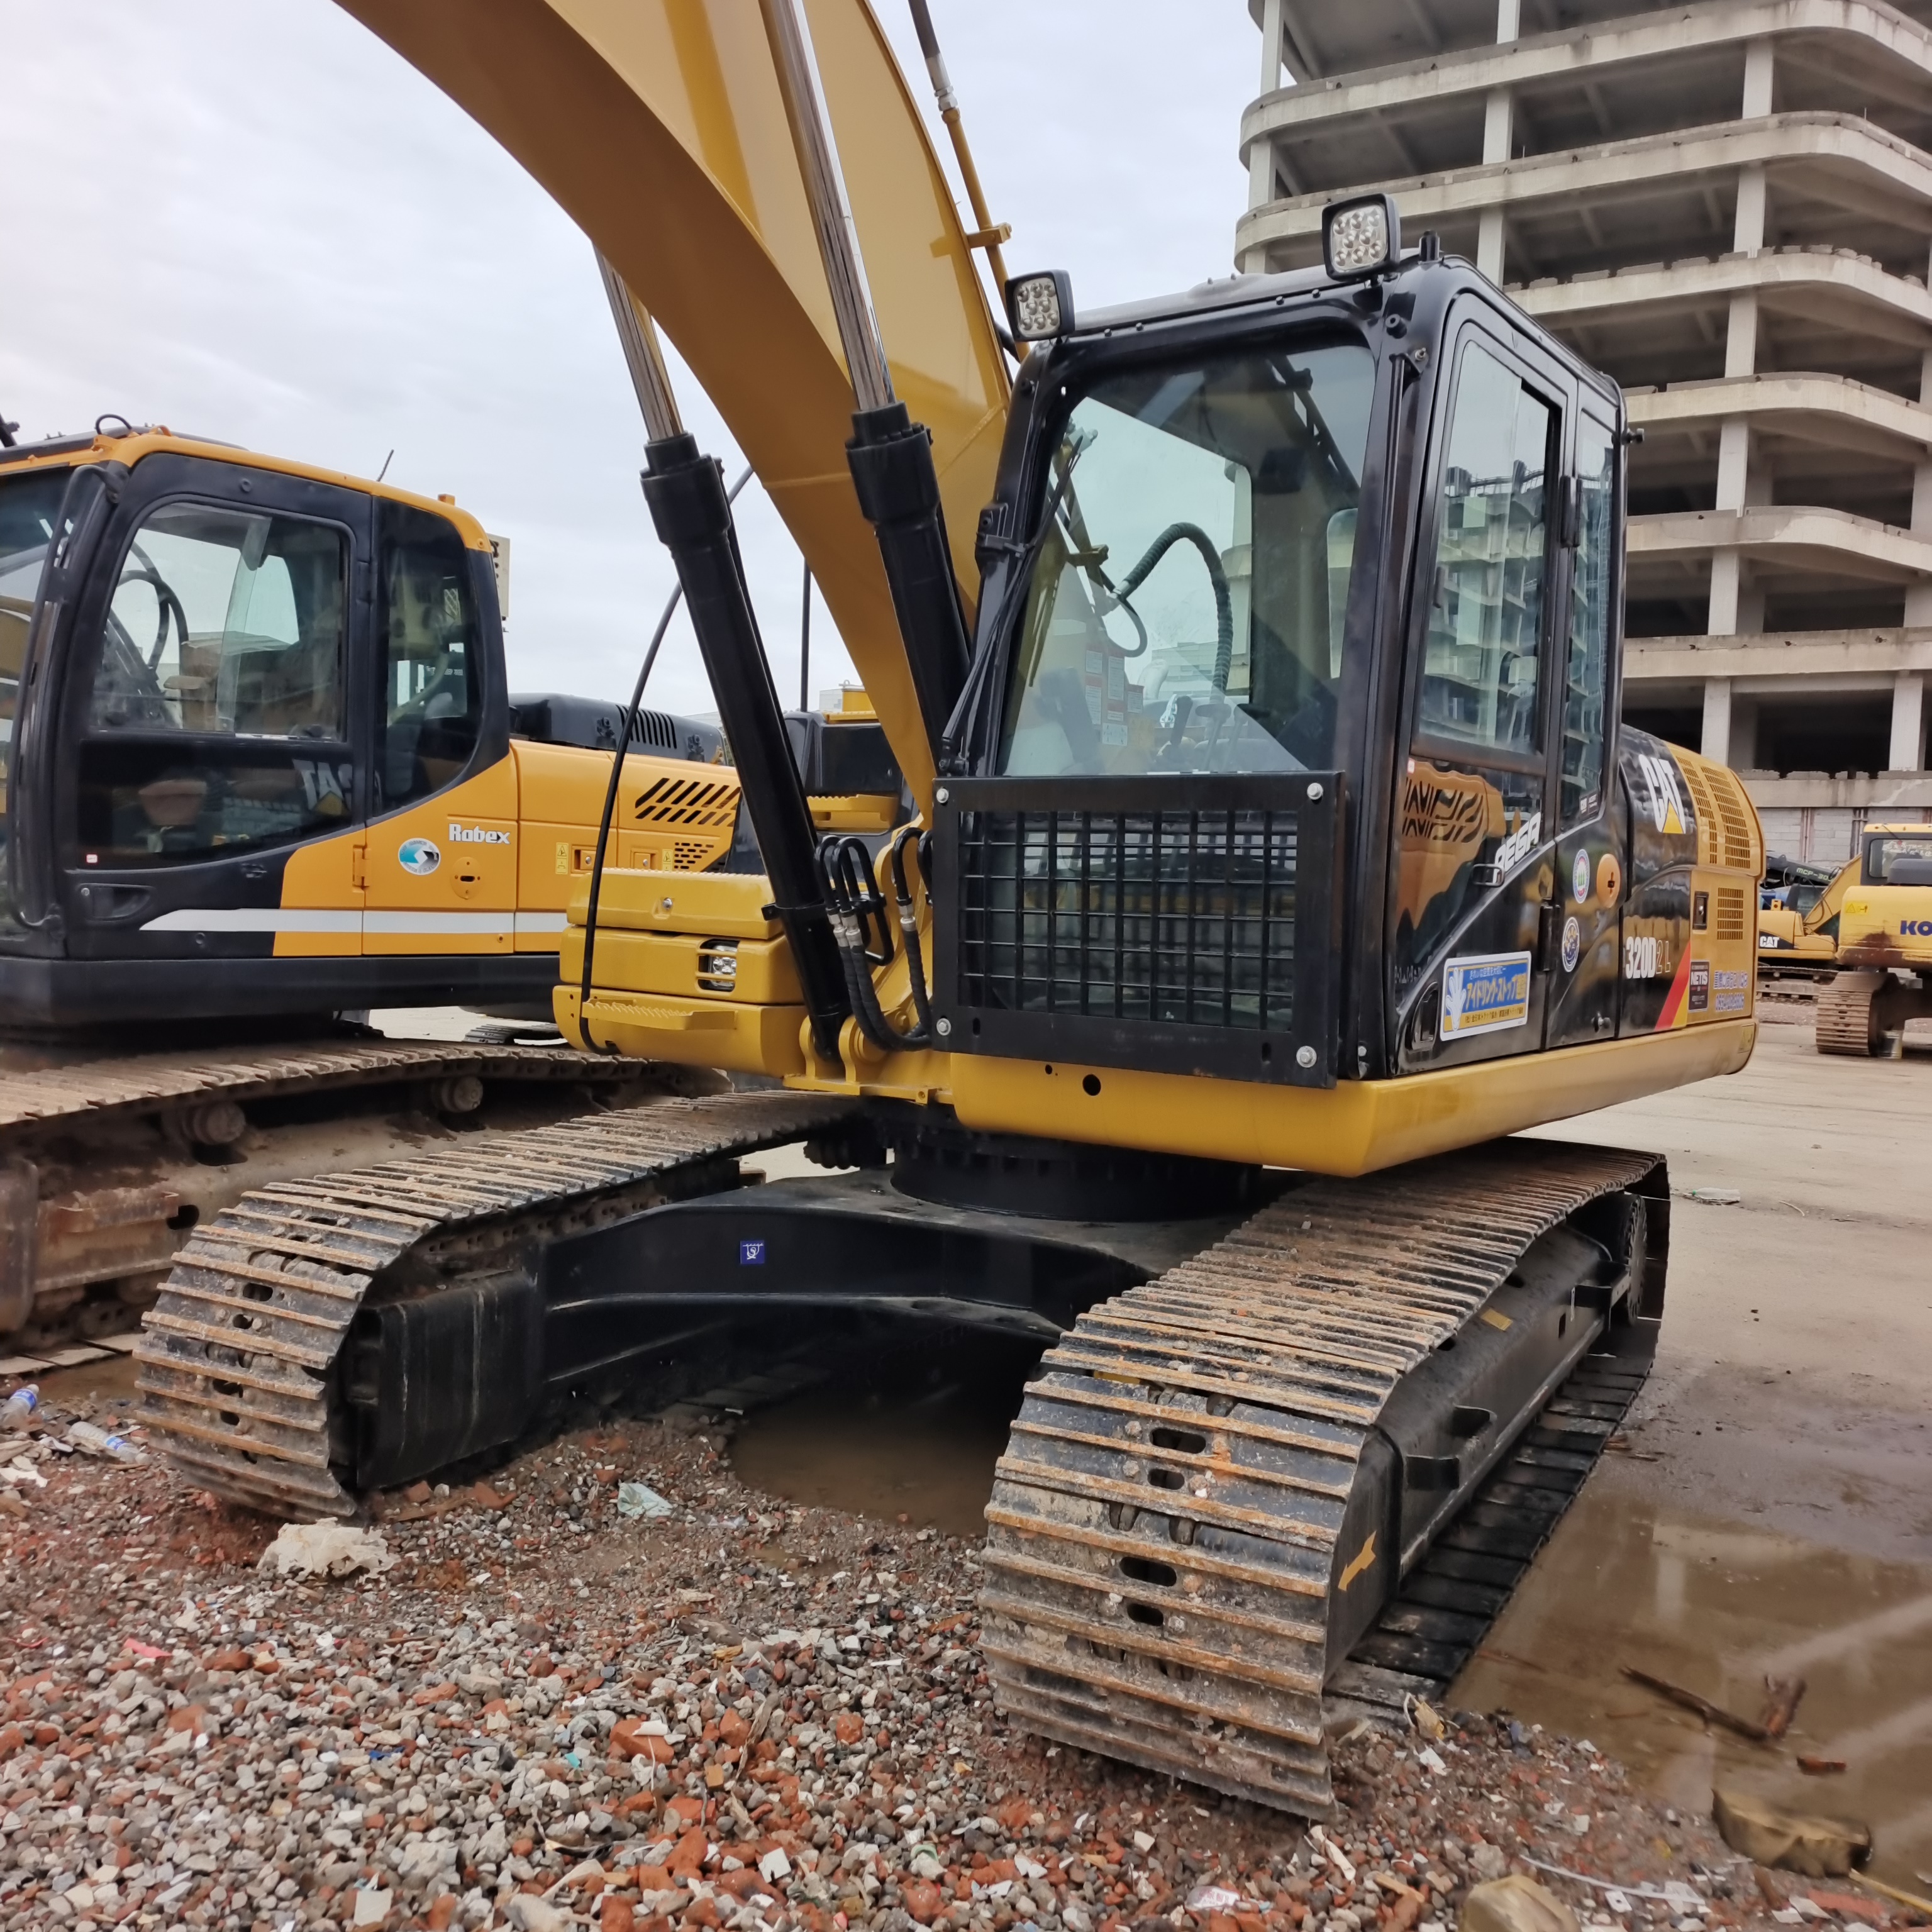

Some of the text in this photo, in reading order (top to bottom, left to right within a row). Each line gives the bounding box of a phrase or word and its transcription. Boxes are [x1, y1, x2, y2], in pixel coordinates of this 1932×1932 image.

[1639, 754, 1686, 835] CAT
[448, 823, 511, 845] Robex
[1900, 920, 1932, 936] KO
[1760, 936, 1780, 948] CAT
[1690, 971, 1708, 986] NETIS
